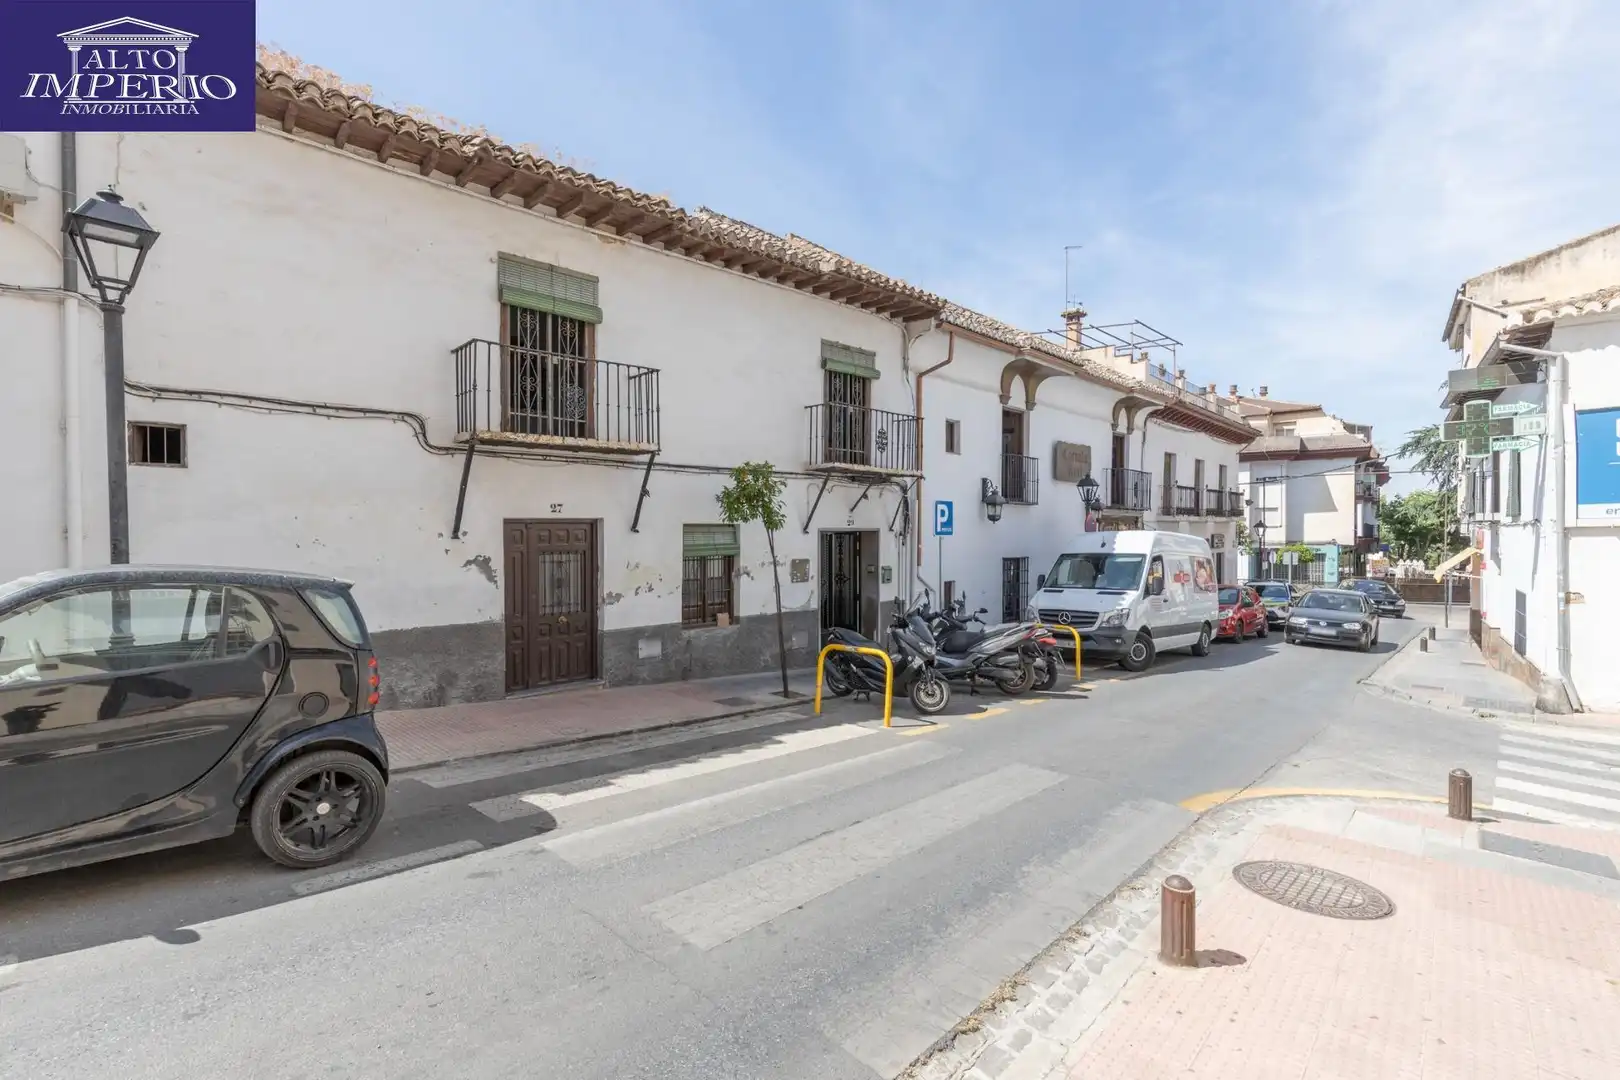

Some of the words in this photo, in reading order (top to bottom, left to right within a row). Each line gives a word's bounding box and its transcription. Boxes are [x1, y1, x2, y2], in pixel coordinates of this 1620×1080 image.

[1494, 403, 1530, 413] FARMACIA
[1494, 440, 1530, 449] FARMACIA
[550, 504, 563, 513] 27
[937, 504, 949, 532] P
